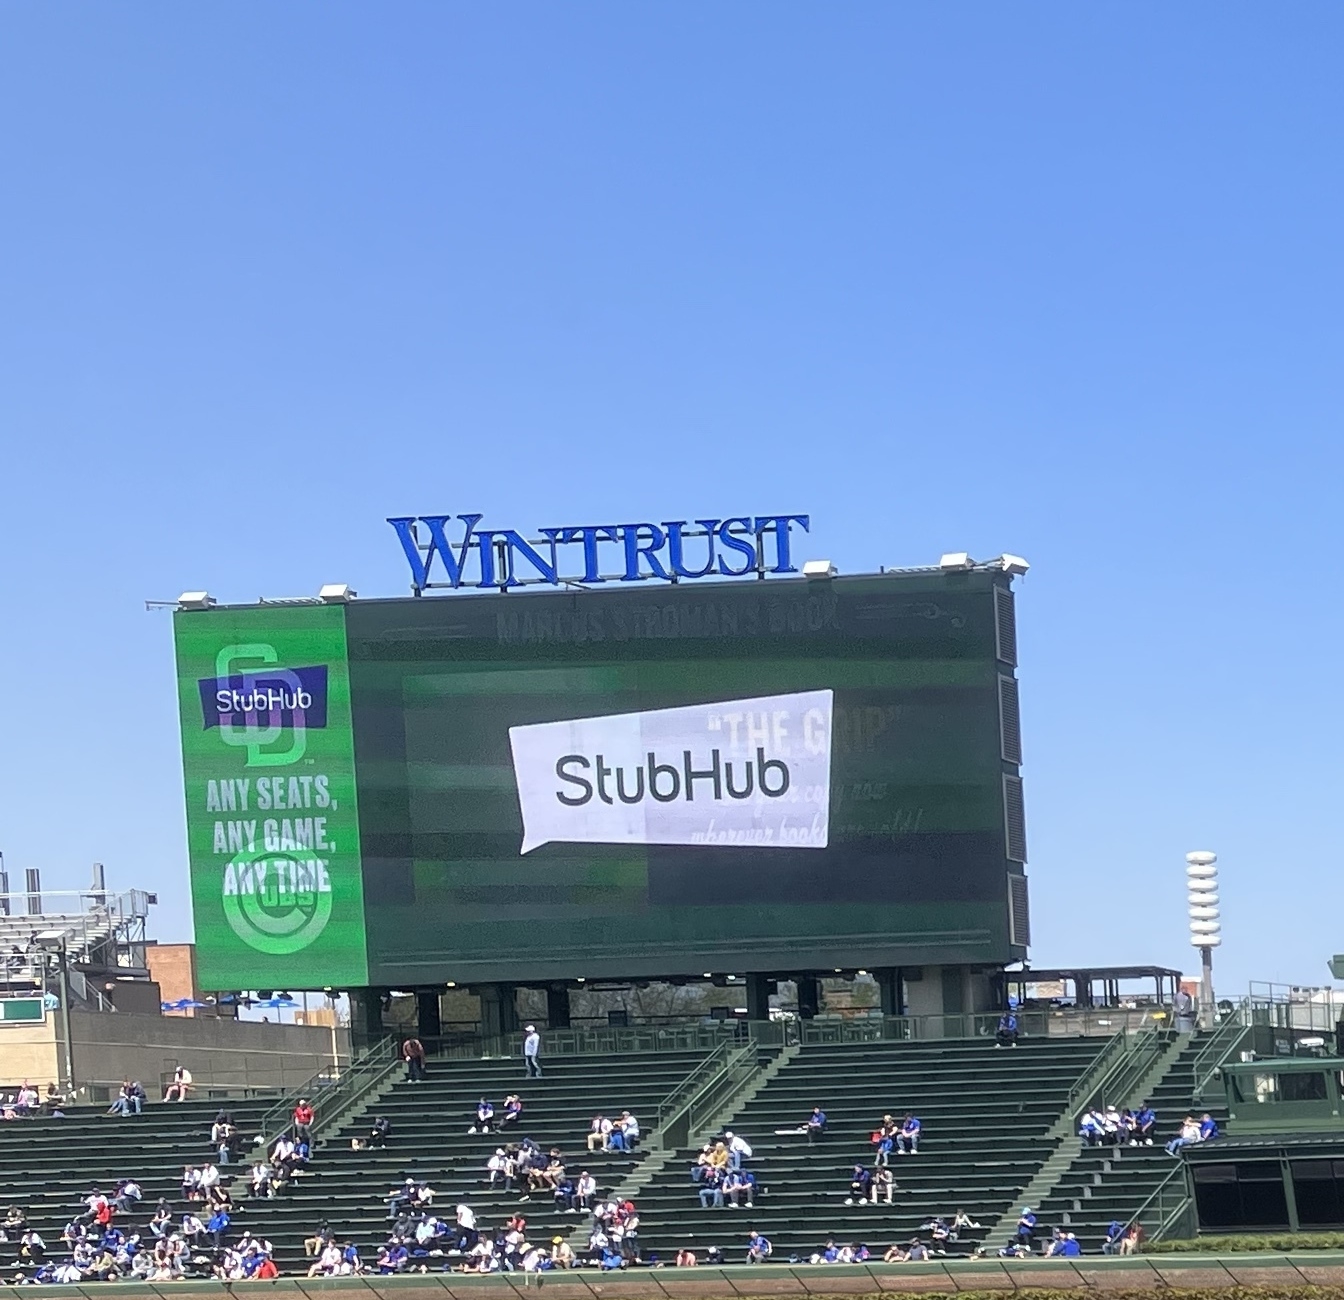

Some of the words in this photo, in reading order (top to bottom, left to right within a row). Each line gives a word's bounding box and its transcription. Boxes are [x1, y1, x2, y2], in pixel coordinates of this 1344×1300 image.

[216, 687, 312, 712] StubHub
[206, 778, 250, 812] ANY
[257, 774, 338, 811] SEATS,
[555, 747, 790, 806] StubHub
[213, 819, 257, 854] ANY
[264, 816, 336, 853] GAME,
[223, 861, 267, 897] ANY
[275, 858, 332, 893] TIME
